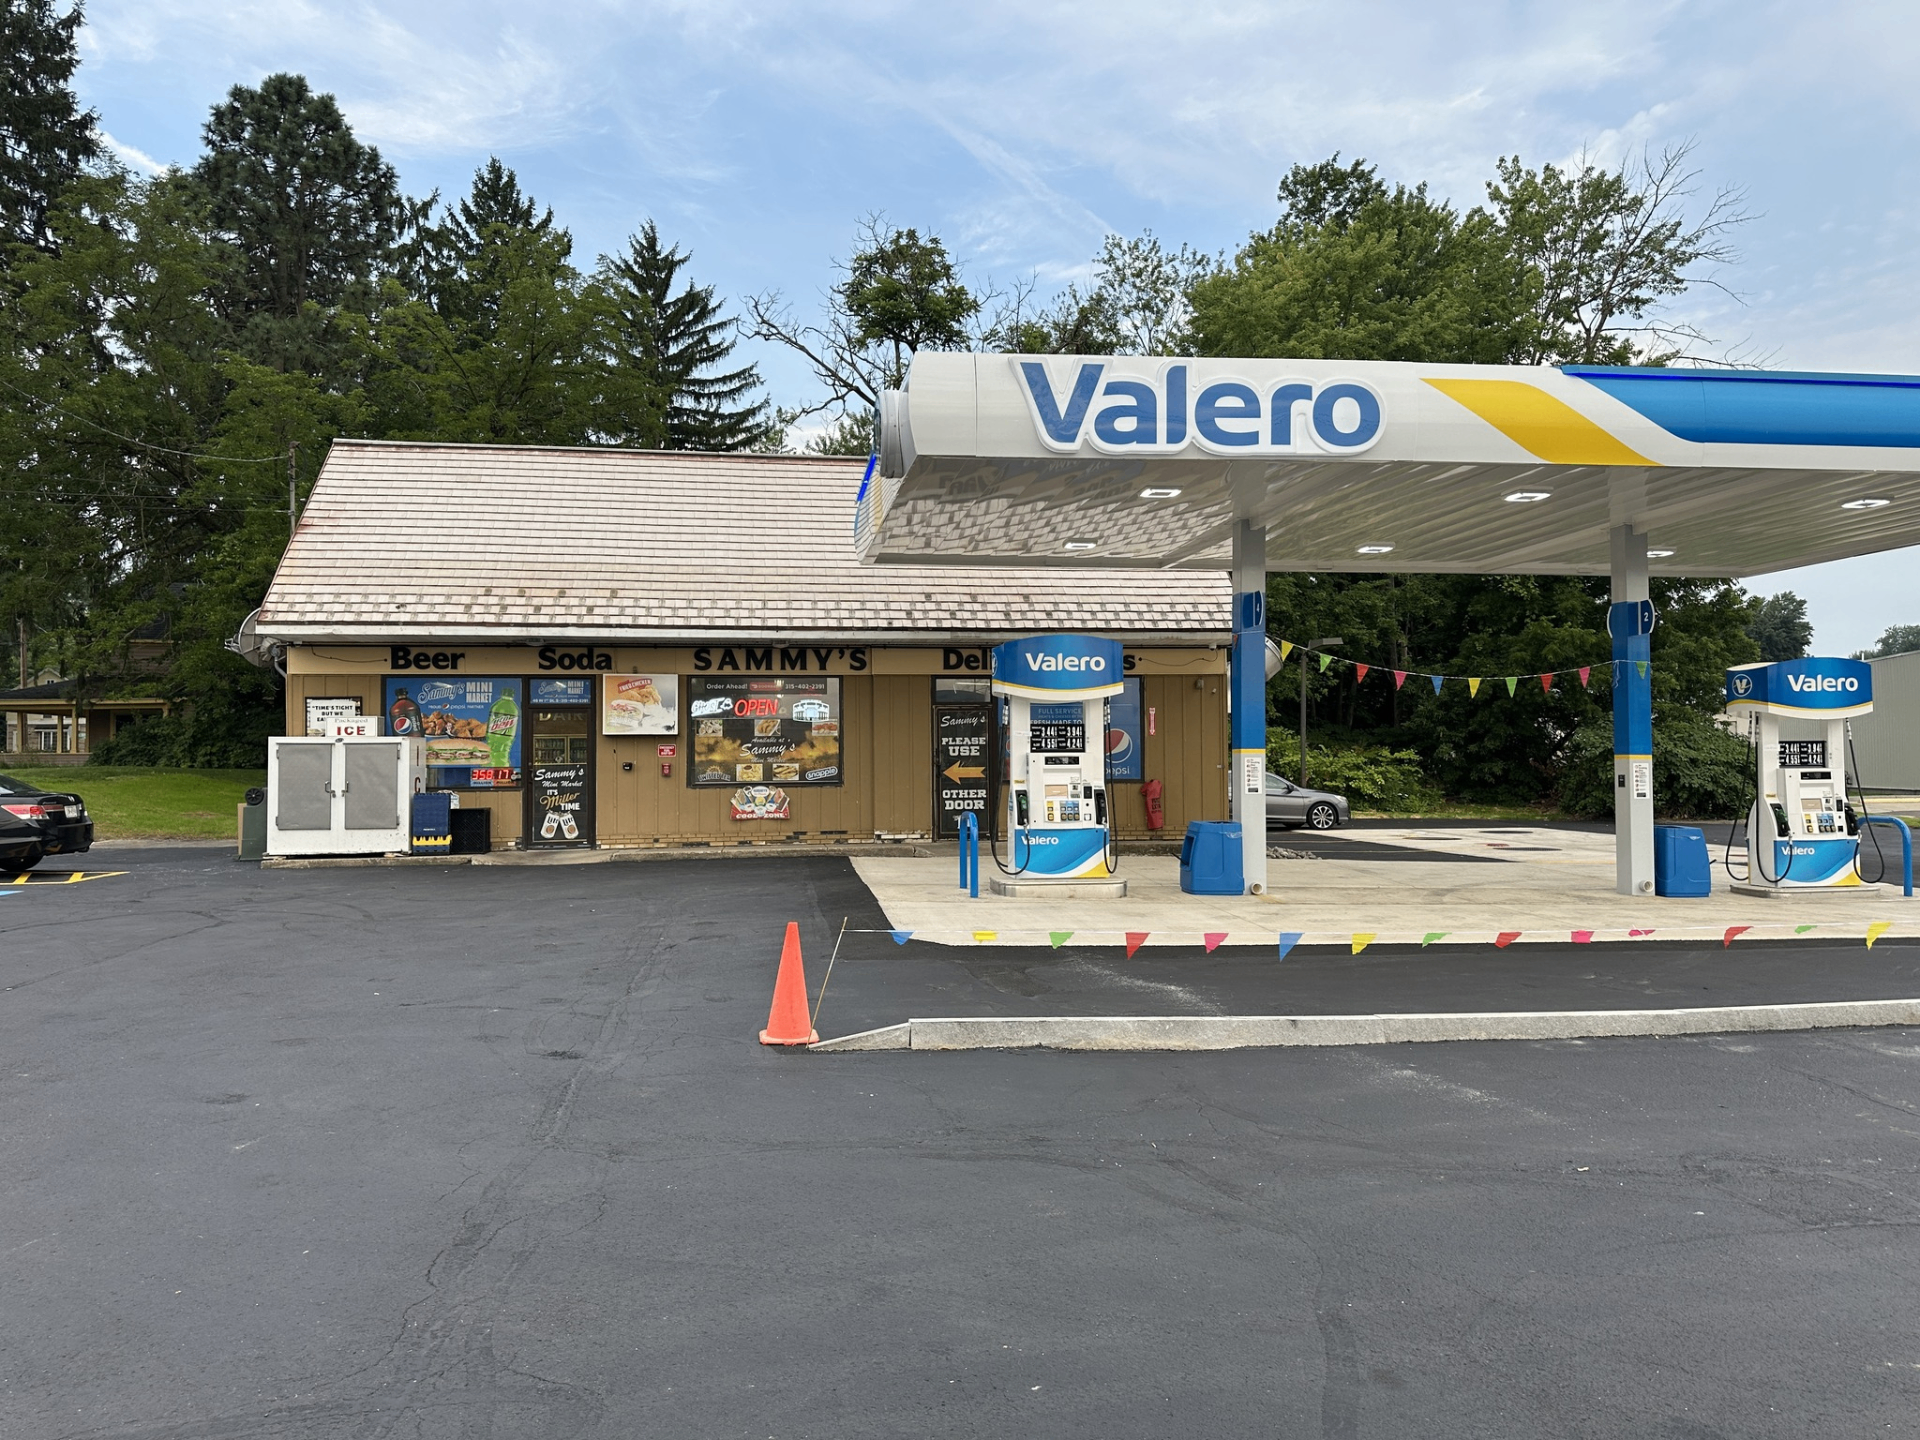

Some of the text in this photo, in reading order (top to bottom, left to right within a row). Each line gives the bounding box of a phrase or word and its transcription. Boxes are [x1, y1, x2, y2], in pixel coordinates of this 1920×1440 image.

[1020, 361, 1382, 449] Valero
[1643, 611, 1649, 622] 2
[390, 646, 613, 671] Beer Soda
[693, 648, 868, 671] SAMMY'S
[1025, 652, 1106, 672] Valero
[466, 681, 493, 693] MINI
[1786, 674, 1859, 692] Valero
[466, 692, 492, 703] MARKET
[734, 698, 779, 717] OPEN
[940, 711, 986, 727] Sammy's
[336, 726, 366, 736] ICE
[941, 737, 986, 745] PLEASE
[740, 738, 796, 757] Sammy's
[948, 746, 980, 756] USE
[534, 764, 585, 781] Sammy's
[541, 780, 559, 788] Mini
[942, 789, 987, 798] OTHER
[540, 792, 581, 811] Miller
[561, 802, 581, 811] TIME
[944, 800, 985, 810] DOOR
[1020, 835, 1059, 845] Valero
[1781, 846, 1816, 856] Valero
